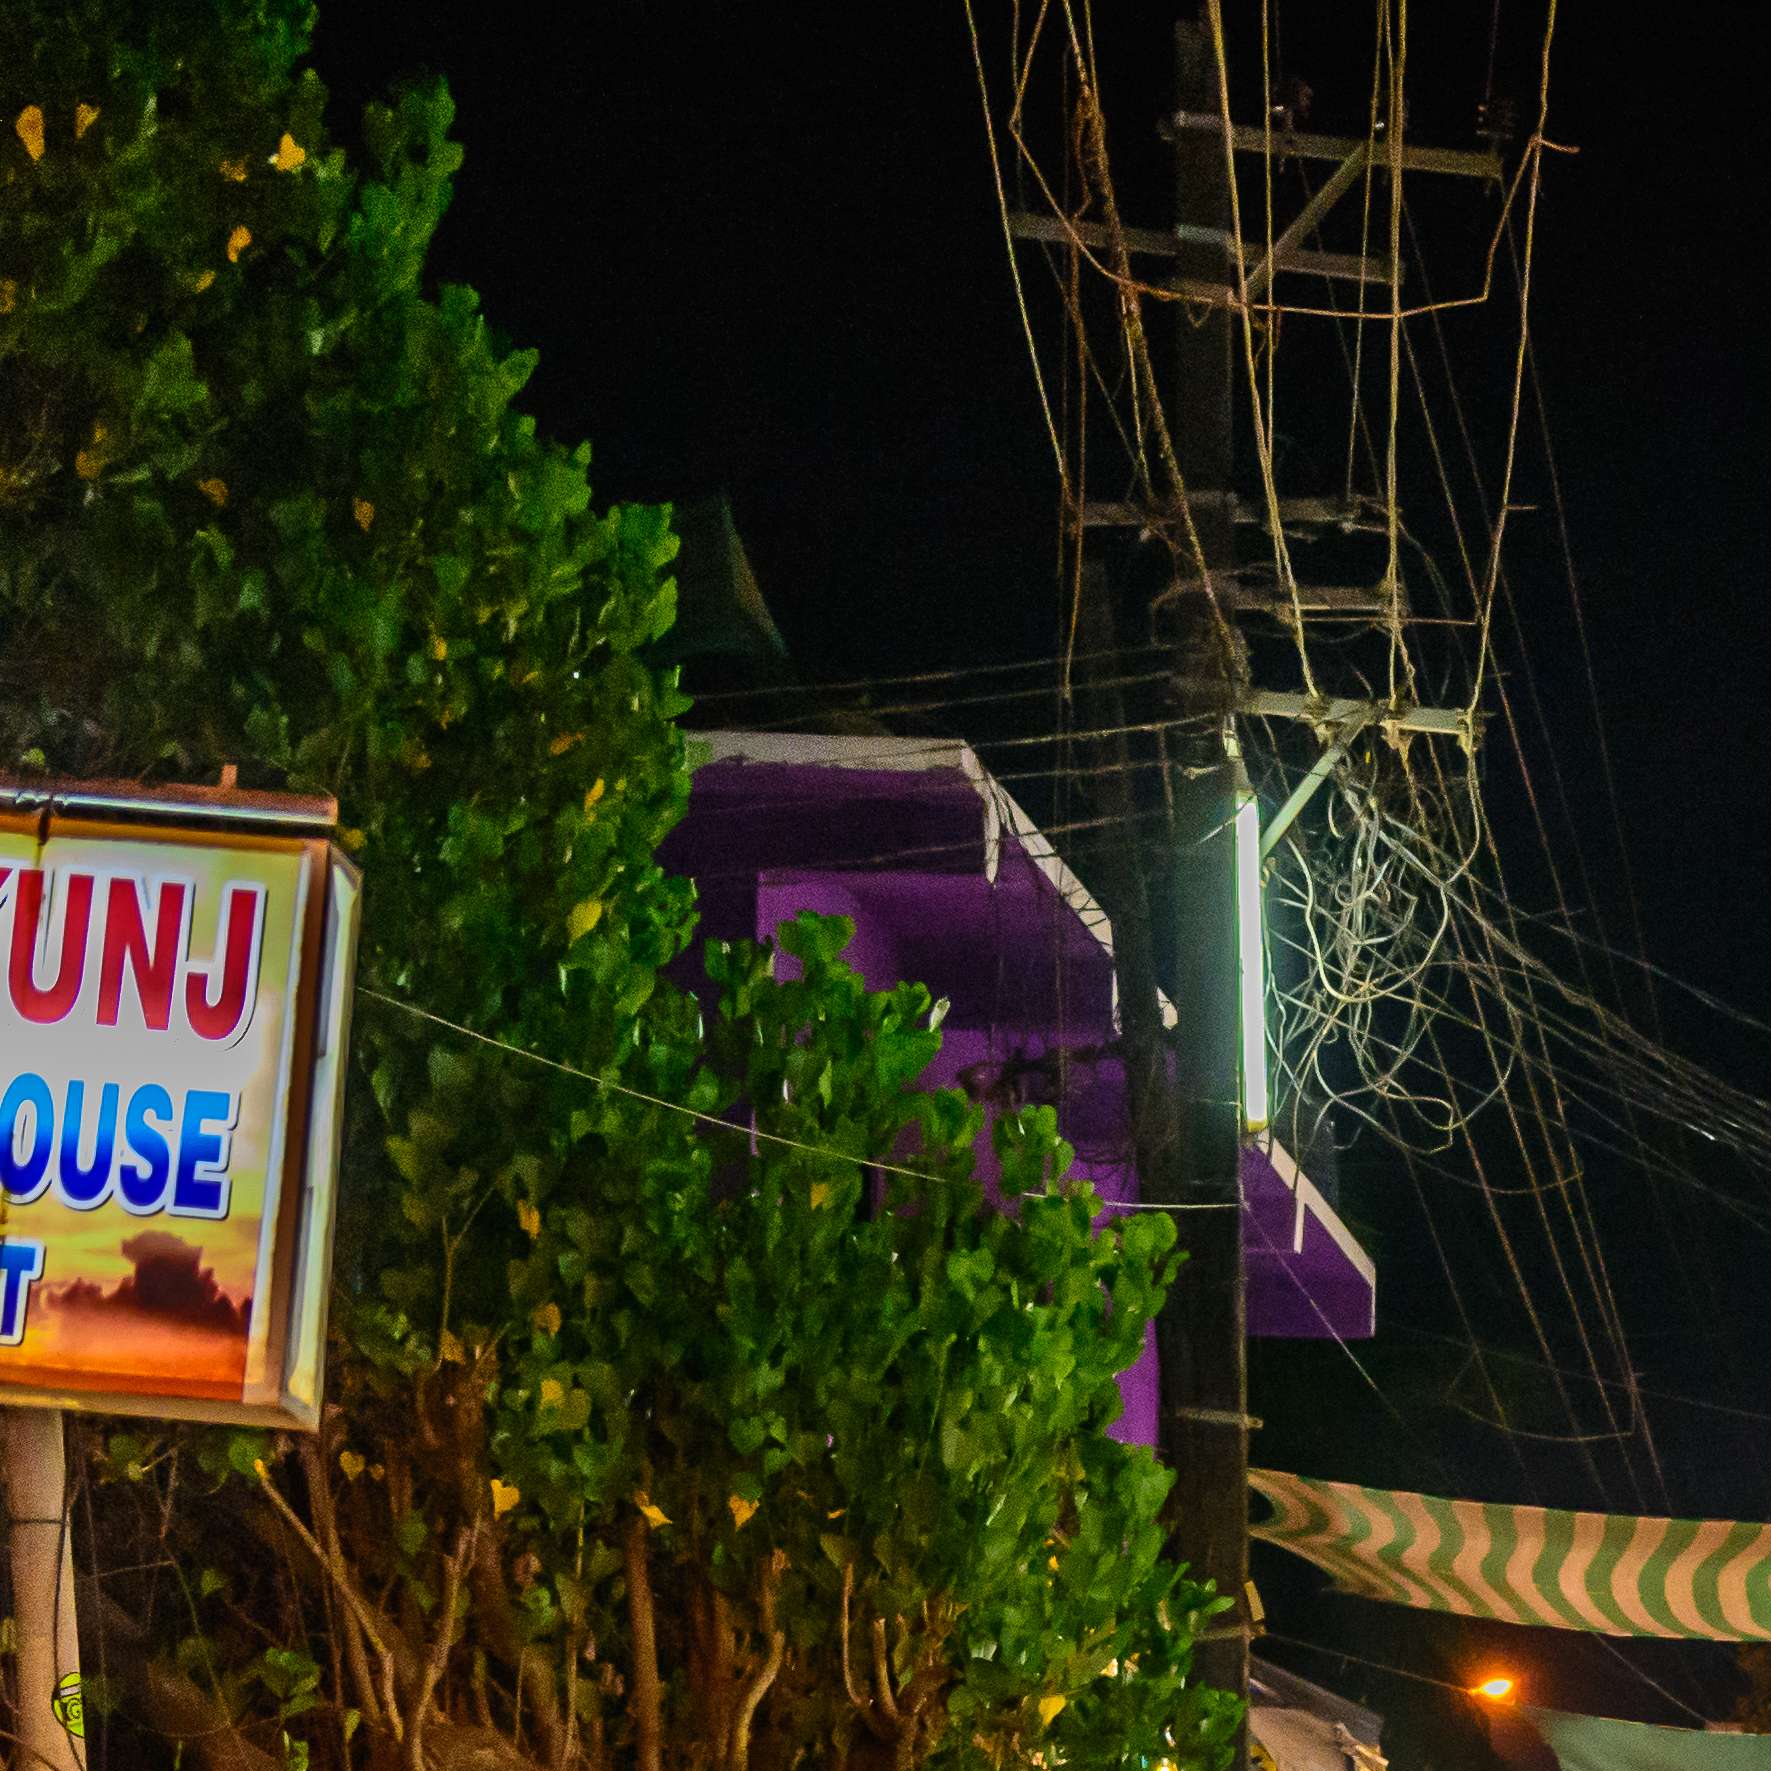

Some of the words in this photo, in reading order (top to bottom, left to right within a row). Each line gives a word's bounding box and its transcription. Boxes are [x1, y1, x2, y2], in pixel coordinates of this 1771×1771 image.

[0, 867, 259, 1041] UNJ
[0, 1072, 232, 1212] OUSE
[0, 1243, 35, 1337] T
